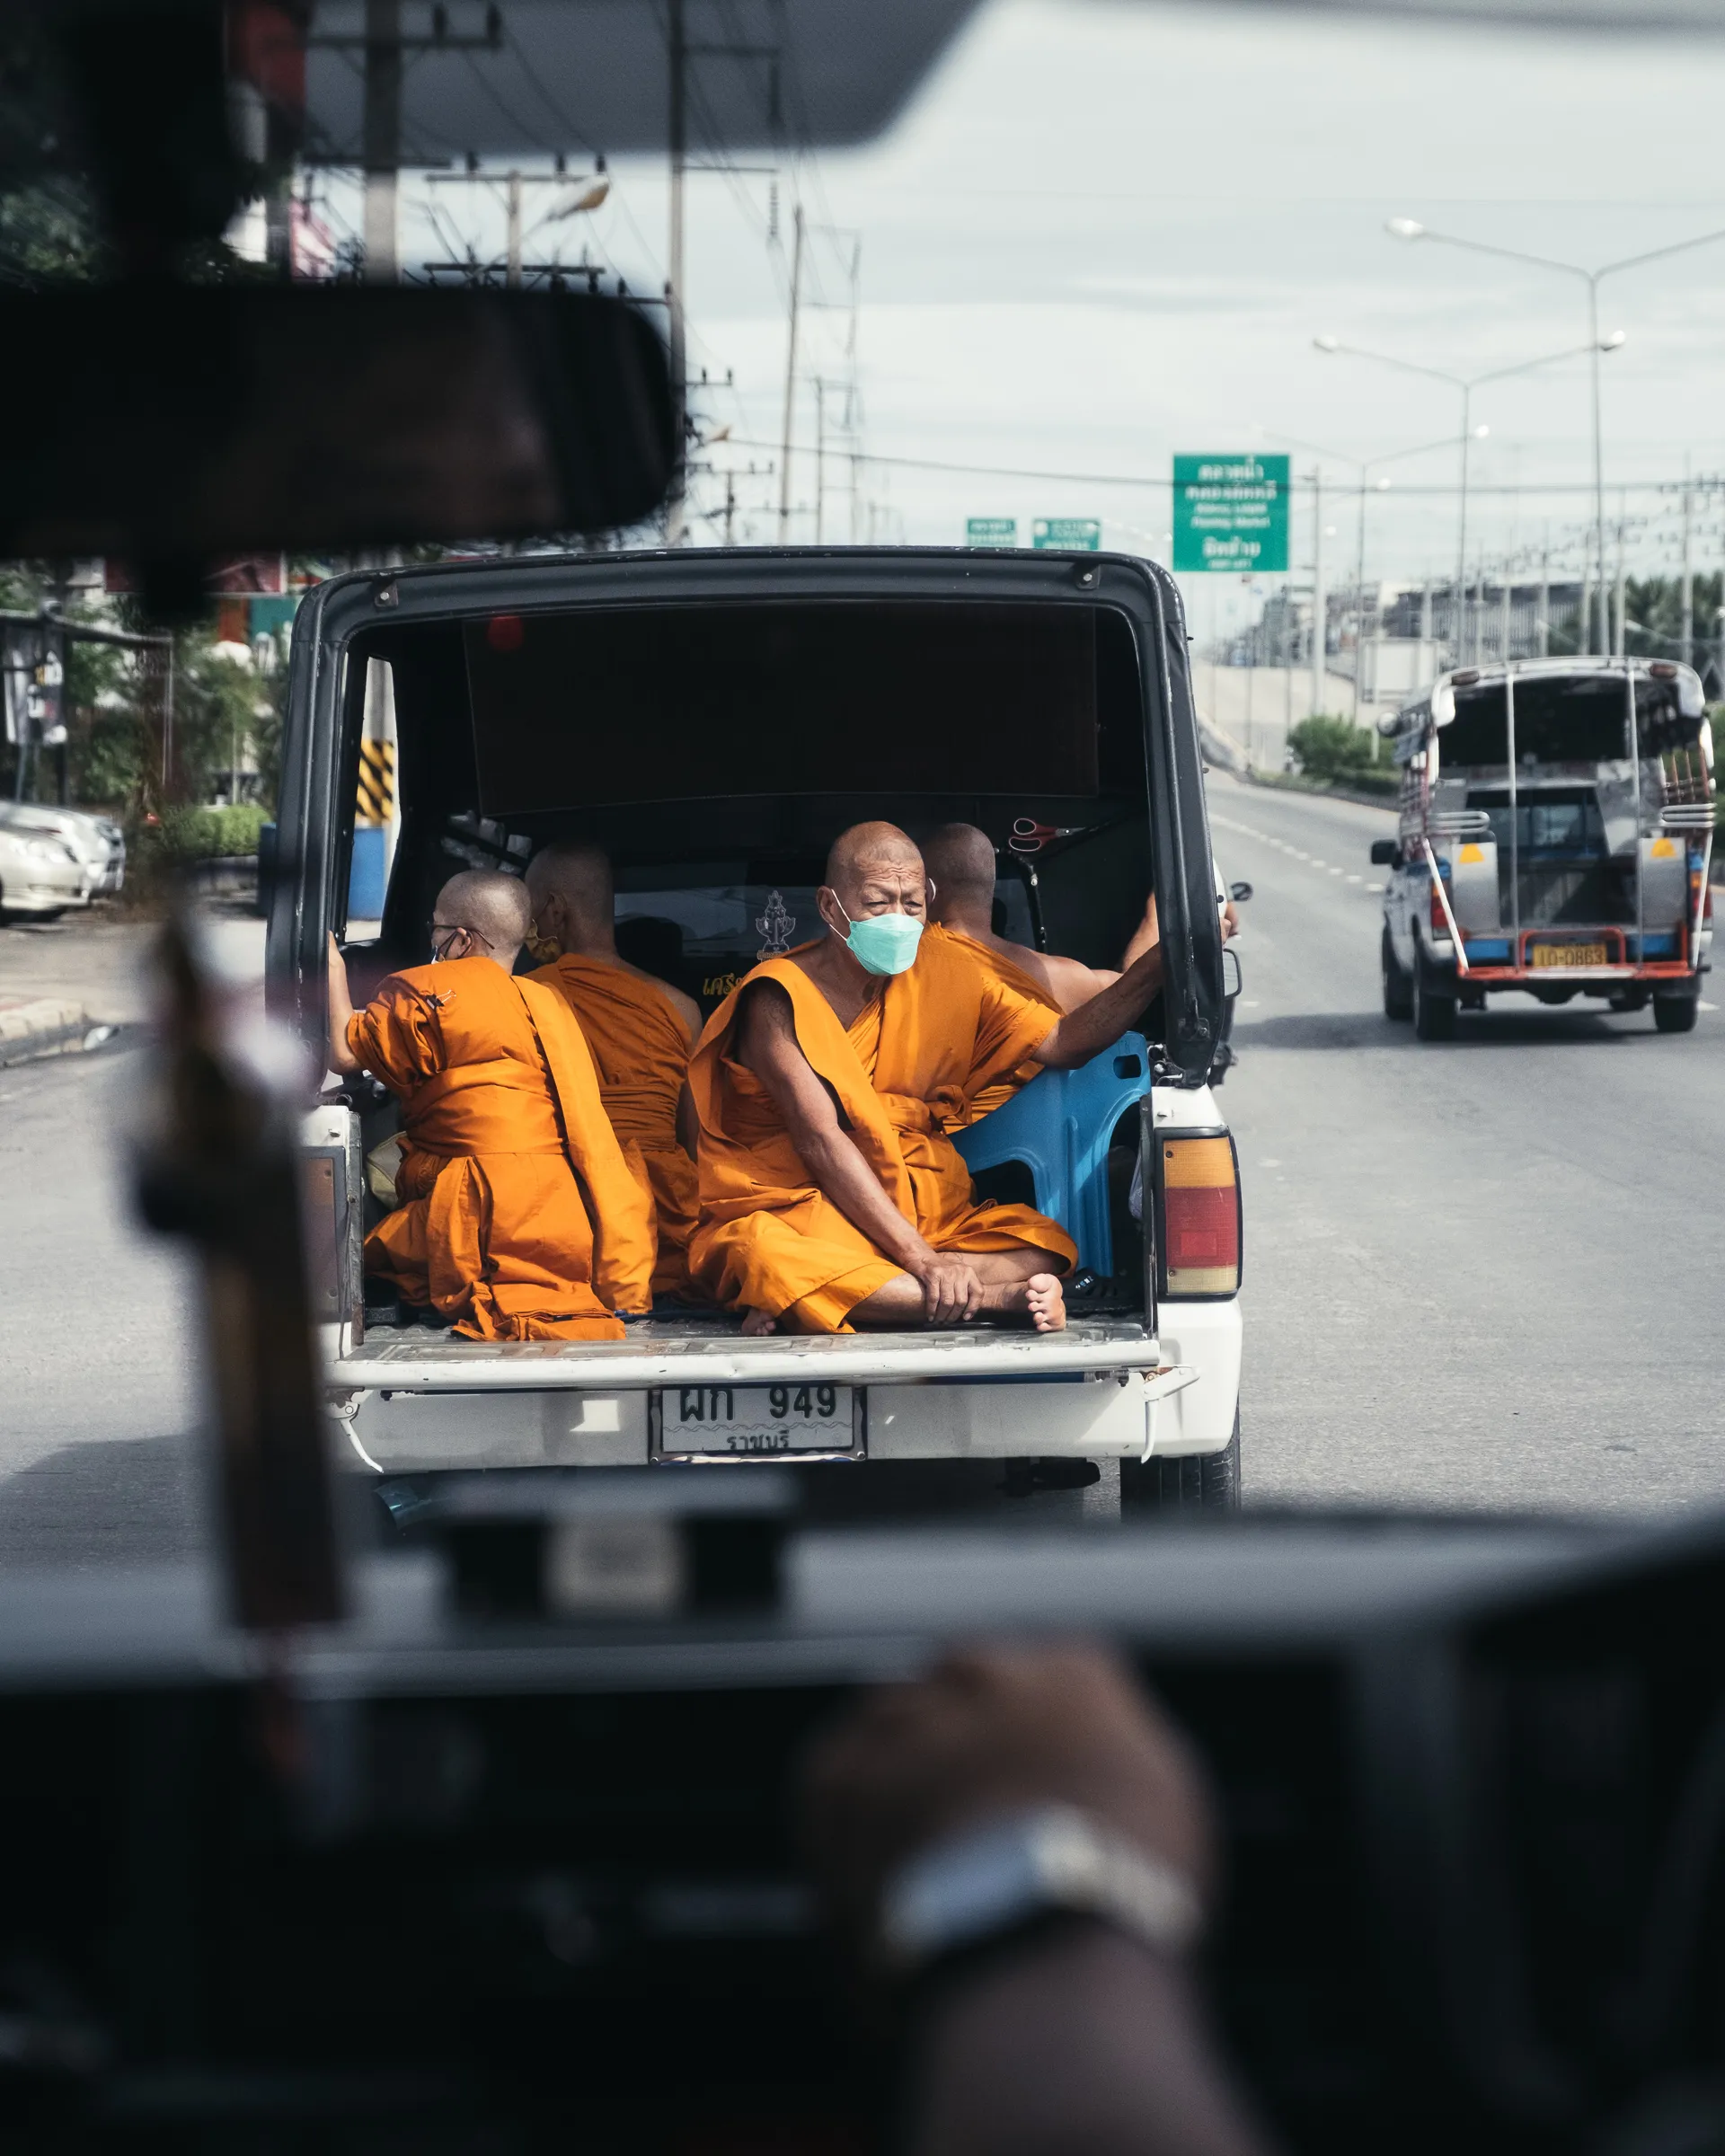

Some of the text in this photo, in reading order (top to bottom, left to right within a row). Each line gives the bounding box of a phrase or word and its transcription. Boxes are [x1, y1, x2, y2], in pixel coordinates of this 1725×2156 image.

[769, 1387, 836, 1418] 949
[727, 1429, 790, 1450] ราชบรี
